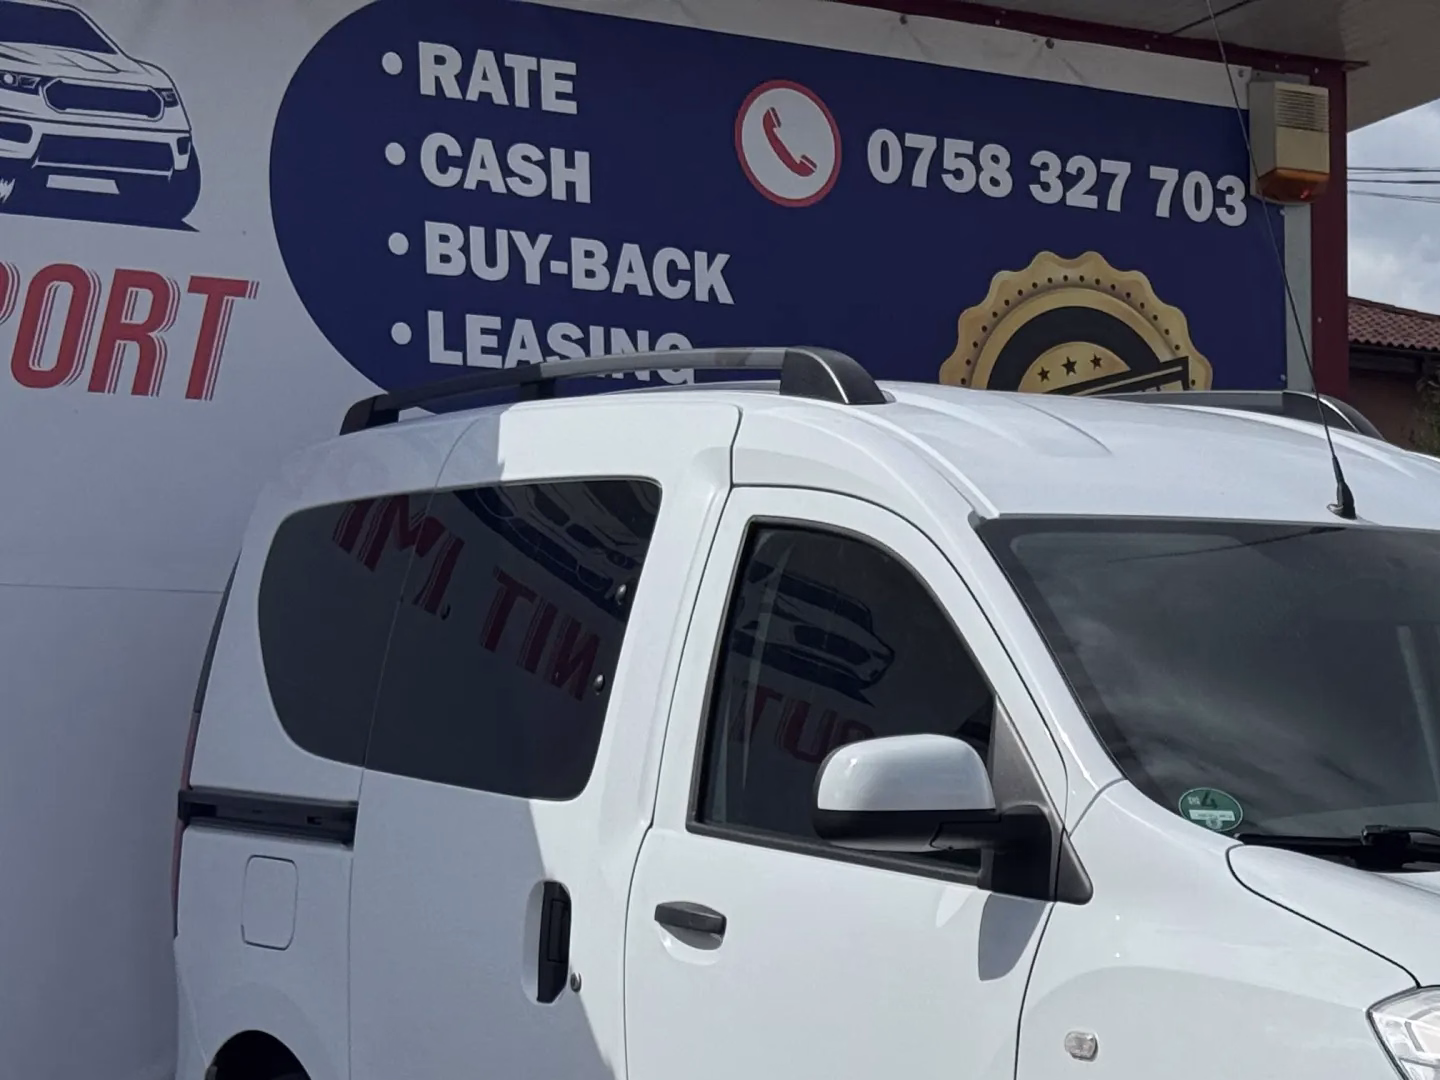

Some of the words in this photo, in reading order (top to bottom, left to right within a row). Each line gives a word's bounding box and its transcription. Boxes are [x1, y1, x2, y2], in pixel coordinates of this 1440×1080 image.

[418, 41, 578, 115] RATE
[419, 132, 592, 204] CASH
[866, 128, 1013, 198] 0758
[1029, 150, 1132, 214] 327
[1150, 165, 1248, 227] 703
[424, 221, 735, 305] BUY-BACK
[427, 309, 695, 385] LEASING
